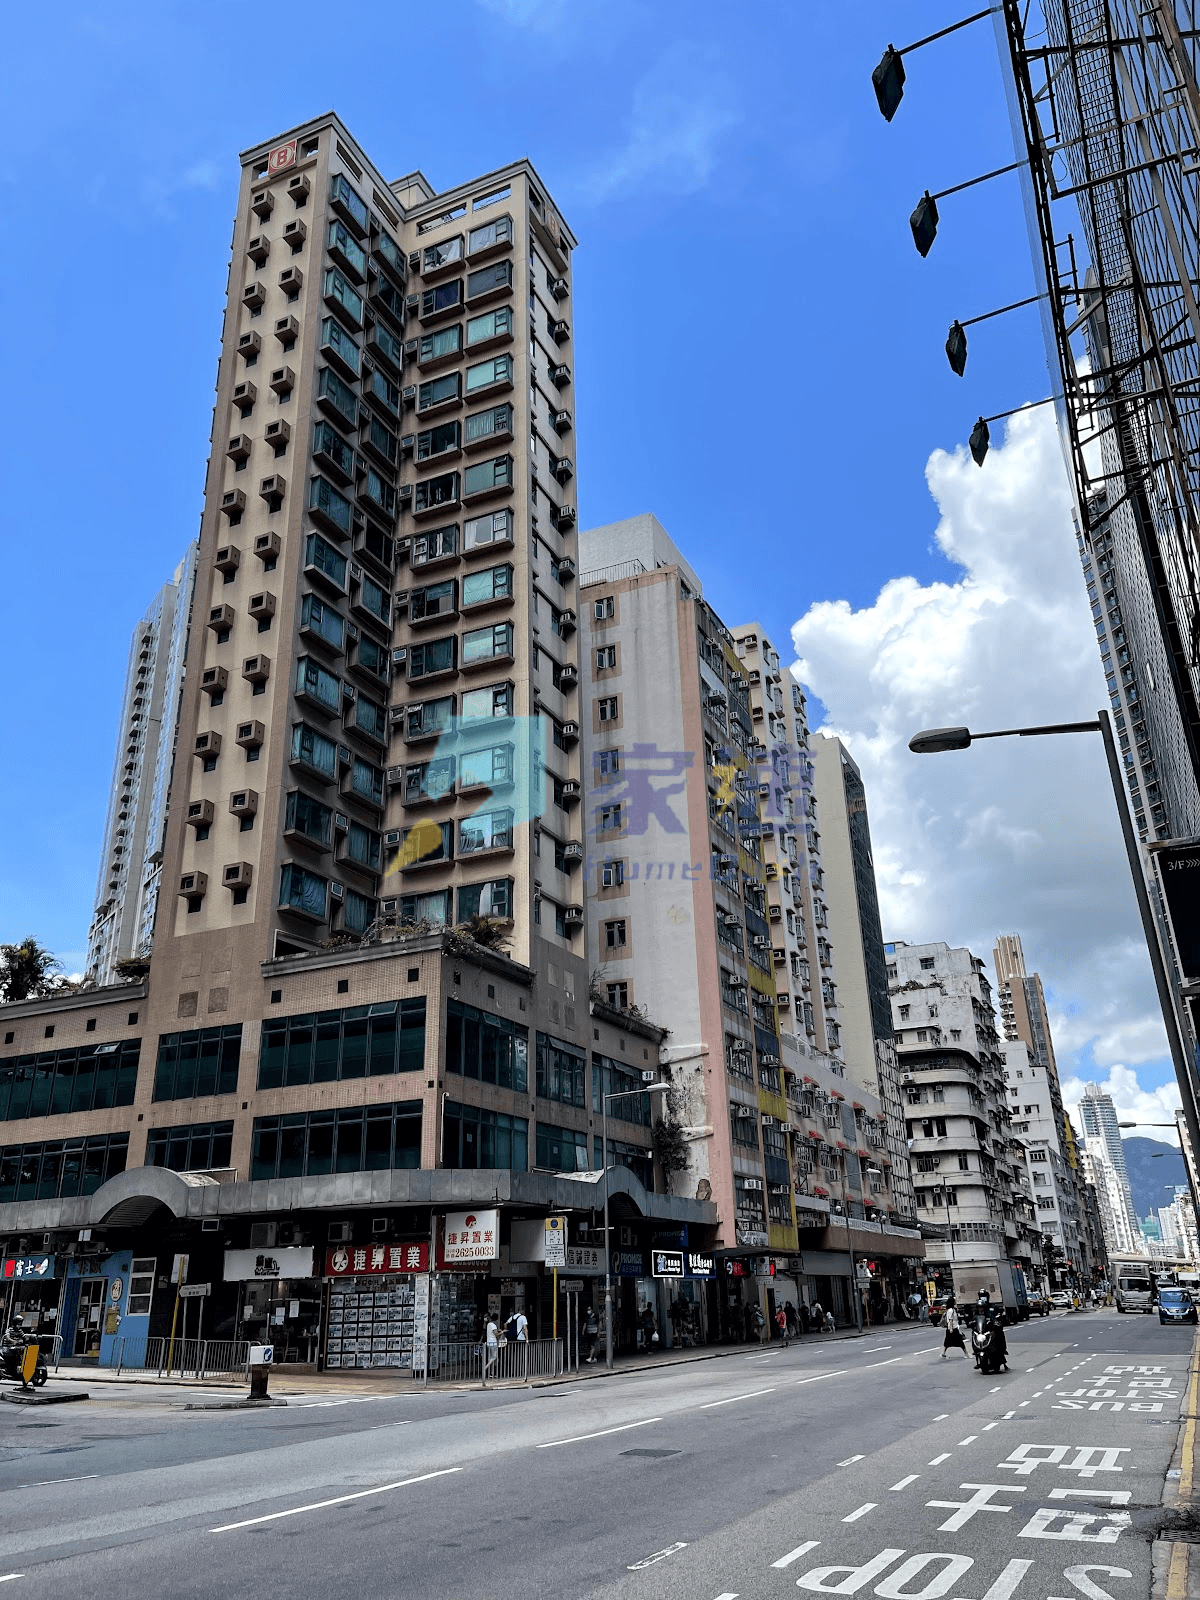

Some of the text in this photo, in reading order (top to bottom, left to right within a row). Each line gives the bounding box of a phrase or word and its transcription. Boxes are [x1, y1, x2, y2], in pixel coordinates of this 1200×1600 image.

[1167, 860, 1185, 871] 3/F
[448, 1230, 493, 1245] 捷昇置業
[455, 1246, 494, 1258] 26250033
[620, 1253, 643, 1265] PROMISE
[15, 1258, 35, 1277] 富士
[1056, 1388, 1180, 1399] STOP
[1051, 1399, 1164, 1412] BUS
